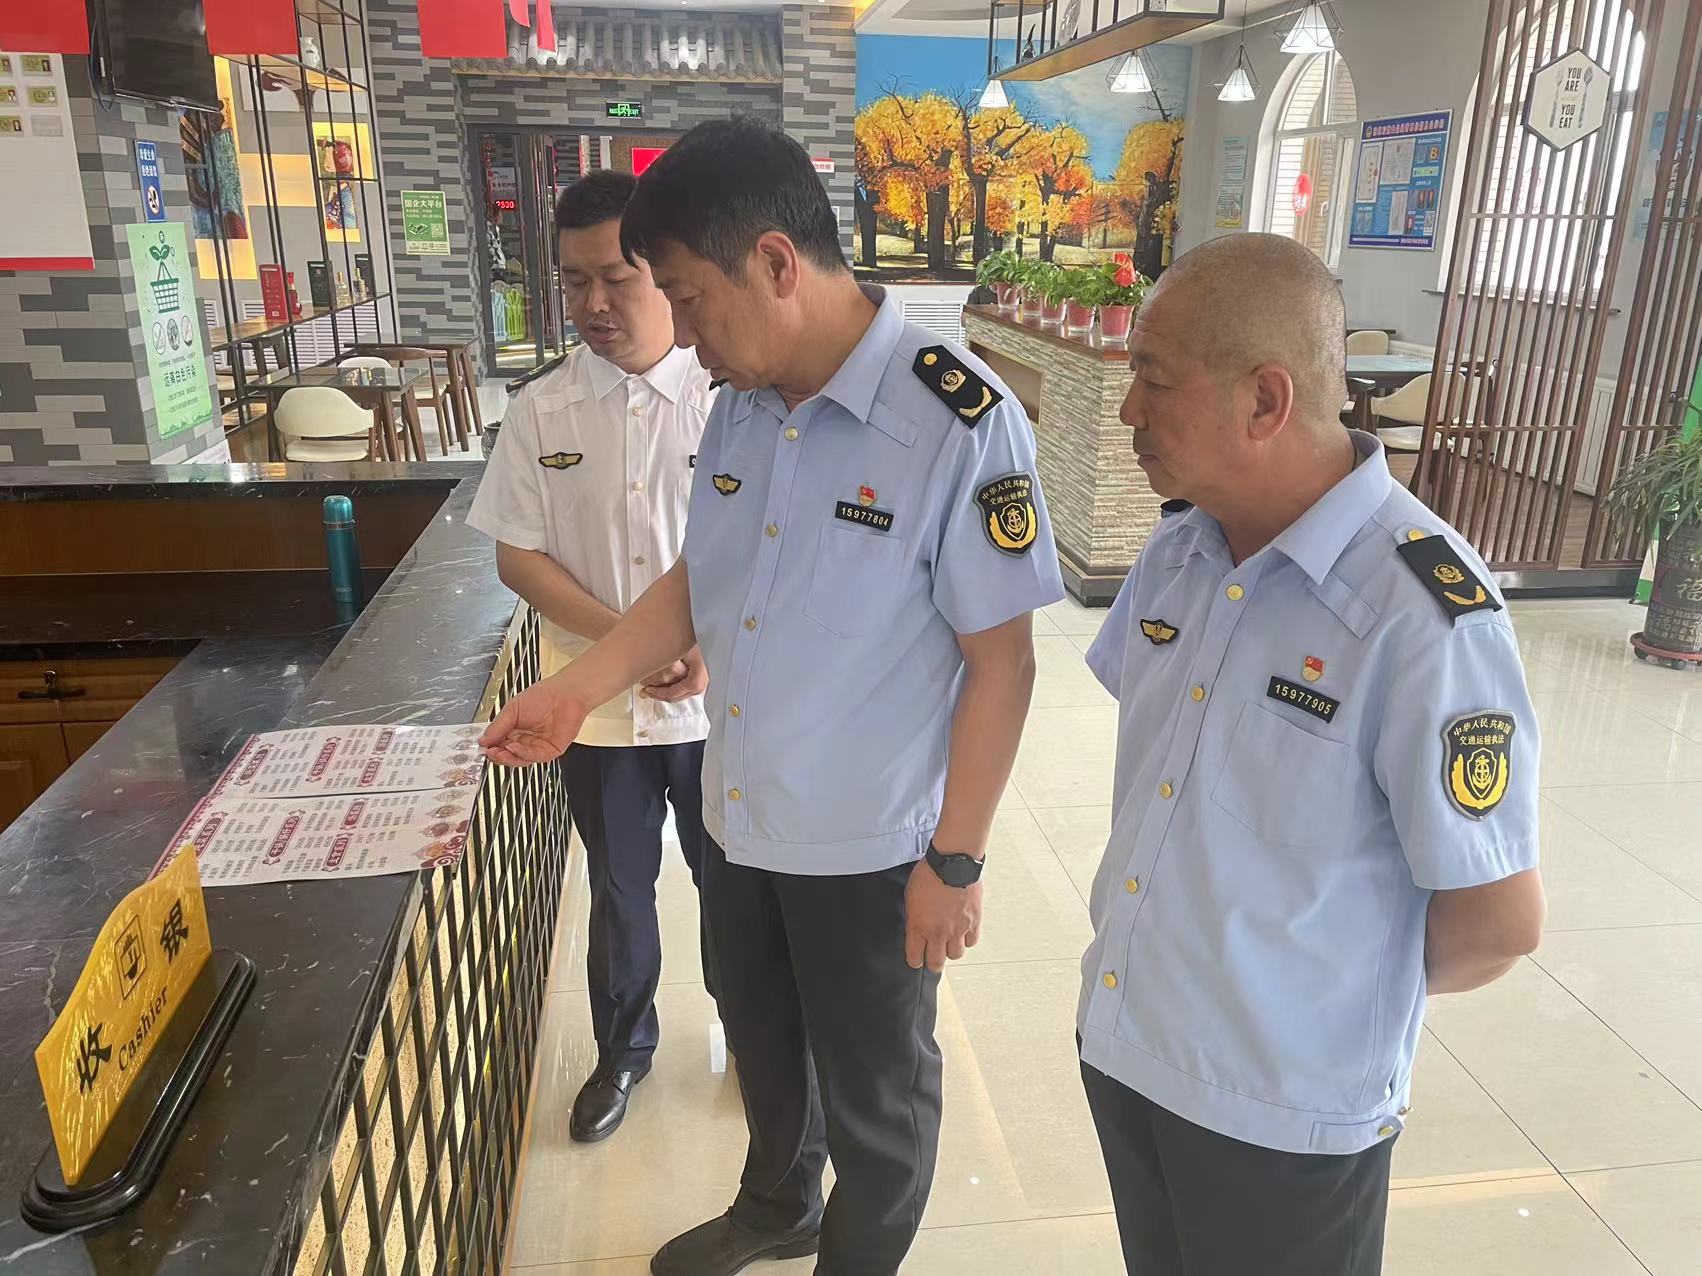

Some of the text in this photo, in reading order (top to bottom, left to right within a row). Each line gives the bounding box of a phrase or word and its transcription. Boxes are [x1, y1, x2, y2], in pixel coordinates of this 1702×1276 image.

[1567, 67, 1582, 79] YOU
[1565, 80, 1579, 92] ARE
[1561, 104, 1576, 116] YOU
[1559, 117, 1573, 128] EAT
[405, 200, 442, 208] 国企大平台
[164, 365, 196, 387] 远离白色污染
[982, 480, 1030, 500] 中华人民共和国
[841, 507, 889, 527] 15977804
[1275, 684, 1332, 715] 15977905
[1454, 718, 1512, 737] 中华人民共和国
[1459, 734, 1506, 746] 交通运输执法
[76, 898, 190, 1095] 收 银
[118, 985, 169, 1072] Cashier
